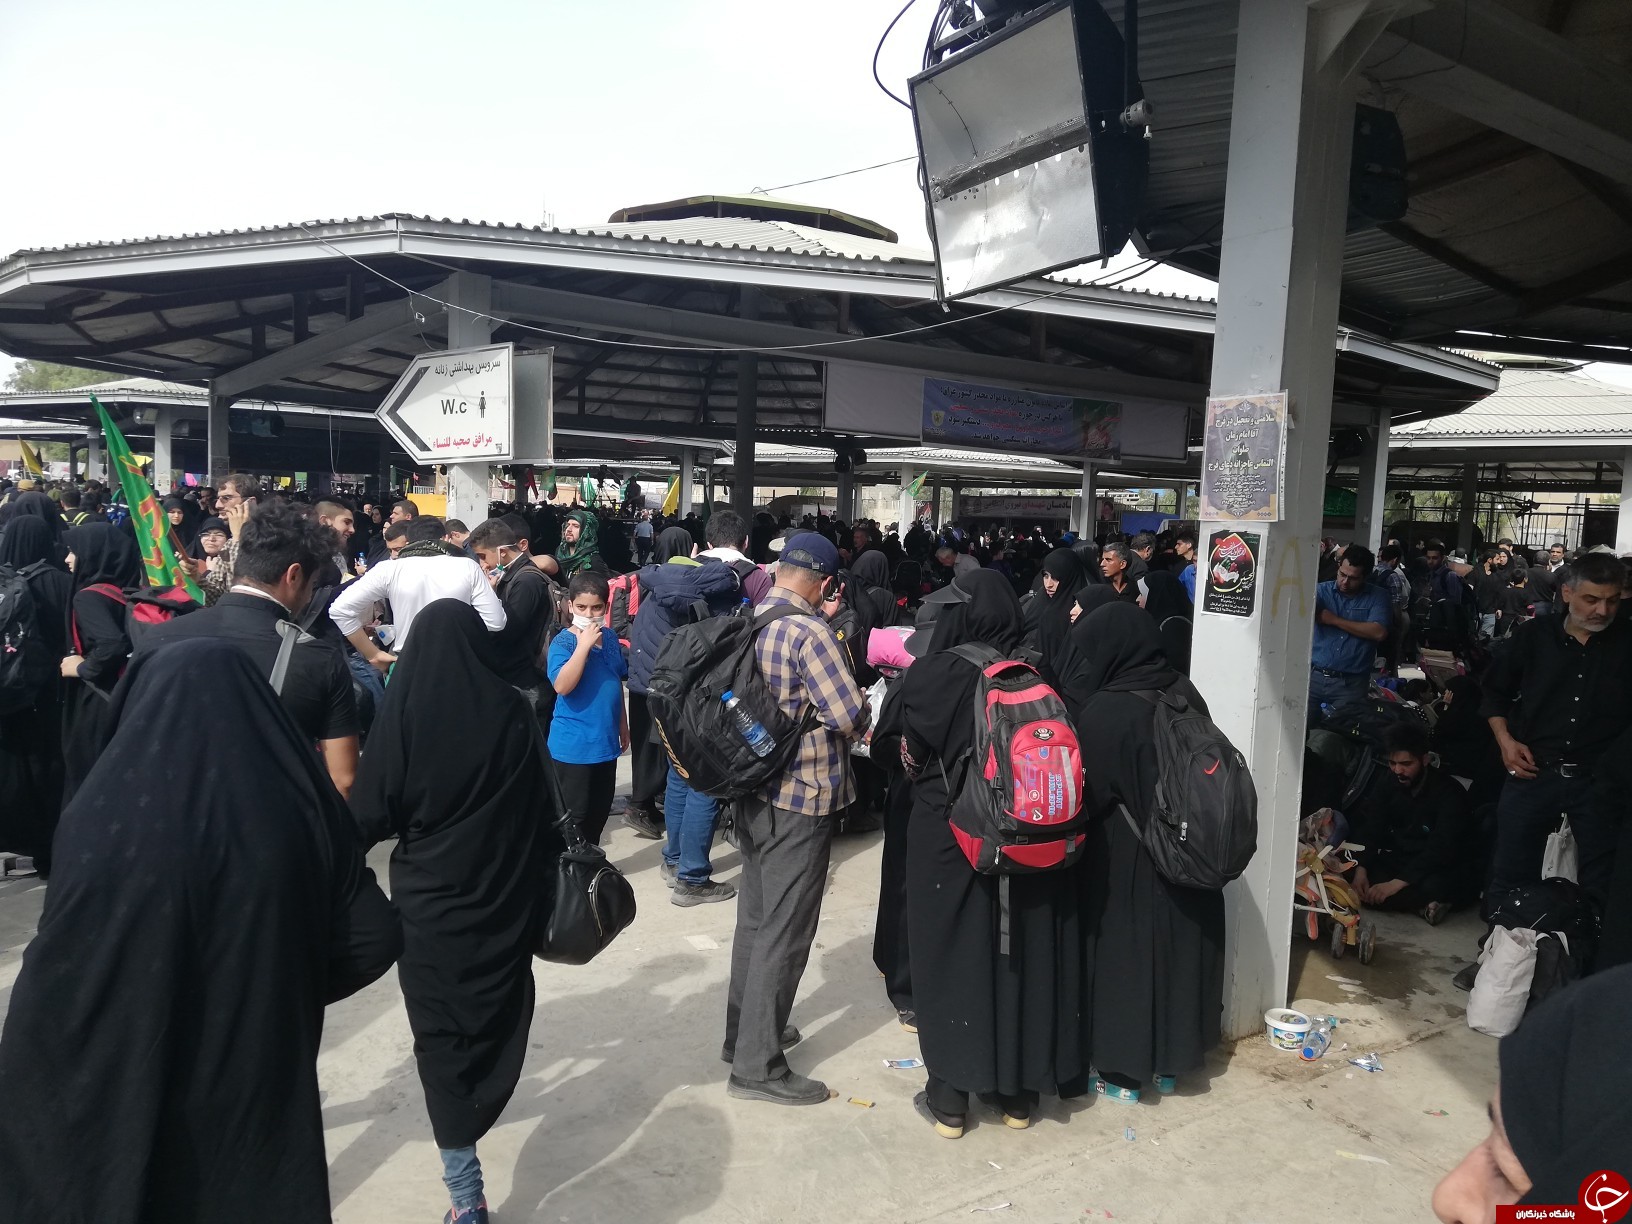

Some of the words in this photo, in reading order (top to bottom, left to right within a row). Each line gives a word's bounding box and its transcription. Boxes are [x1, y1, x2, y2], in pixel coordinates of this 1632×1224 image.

[434, 365, 448, 376] زنانه
[449, 361, 474, 377] بهداشتی
[475, 360, 501, 375] سرویس
[472, 432, 493, 448] مرافق
[1232, 444, 1250, 456] صلوات
